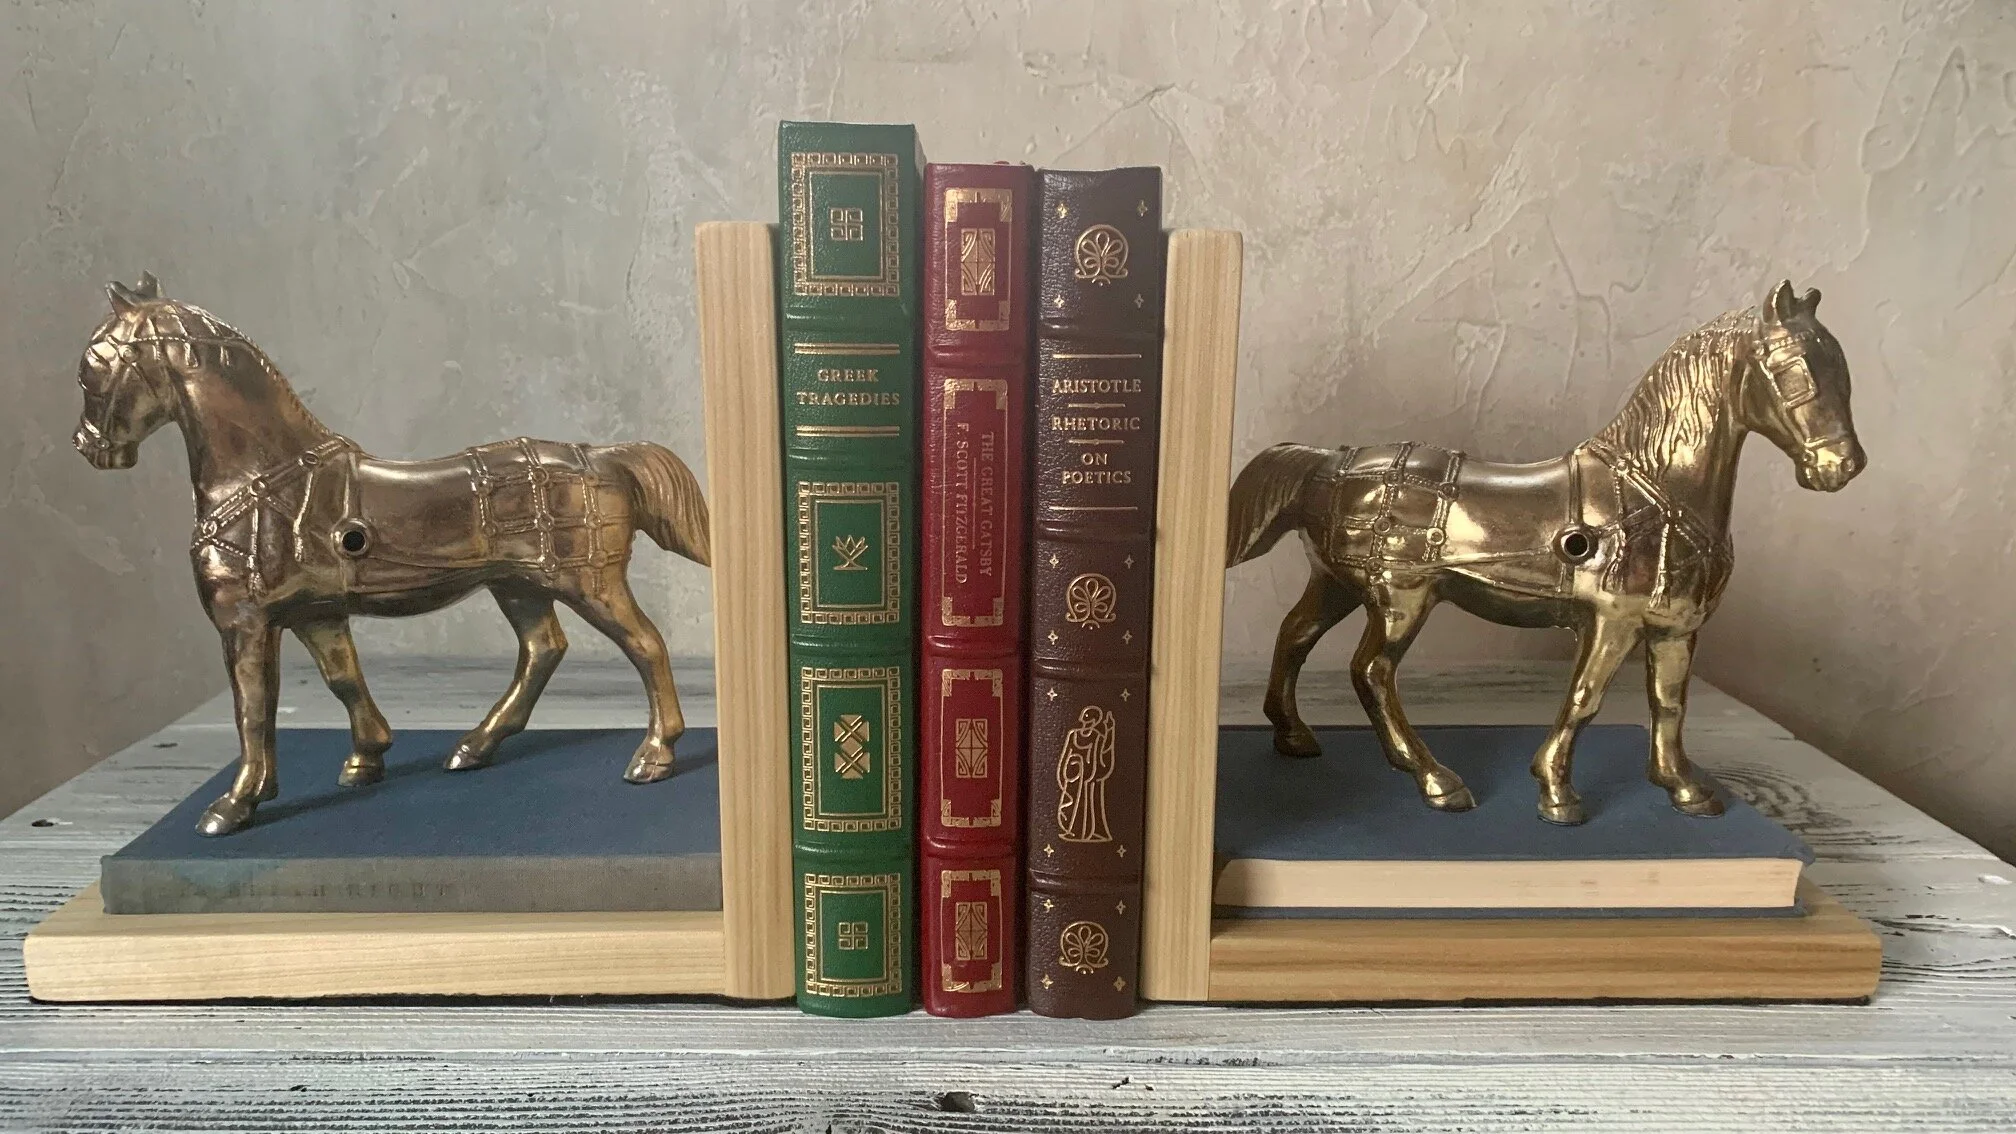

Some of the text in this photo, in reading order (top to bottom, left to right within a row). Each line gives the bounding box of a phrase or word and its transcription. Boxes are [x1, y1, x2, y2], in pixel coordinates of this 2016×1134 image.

[817, 368, 879, 382] GREEK
[1052, 379, 1142, 394] ARISTOTLE
[796, 391, 900, 406] TRAGEDIES
[1052, 417, 1140, 431] RHETORIC
[1081, 452, 1108, 465] ON
[1062, 470, 1132, 484] POETICS
[955, 422, 969, 584] F. SCOTT FITZGERALD
[979, 431, 994, 577] THE GREAT GATSBY
